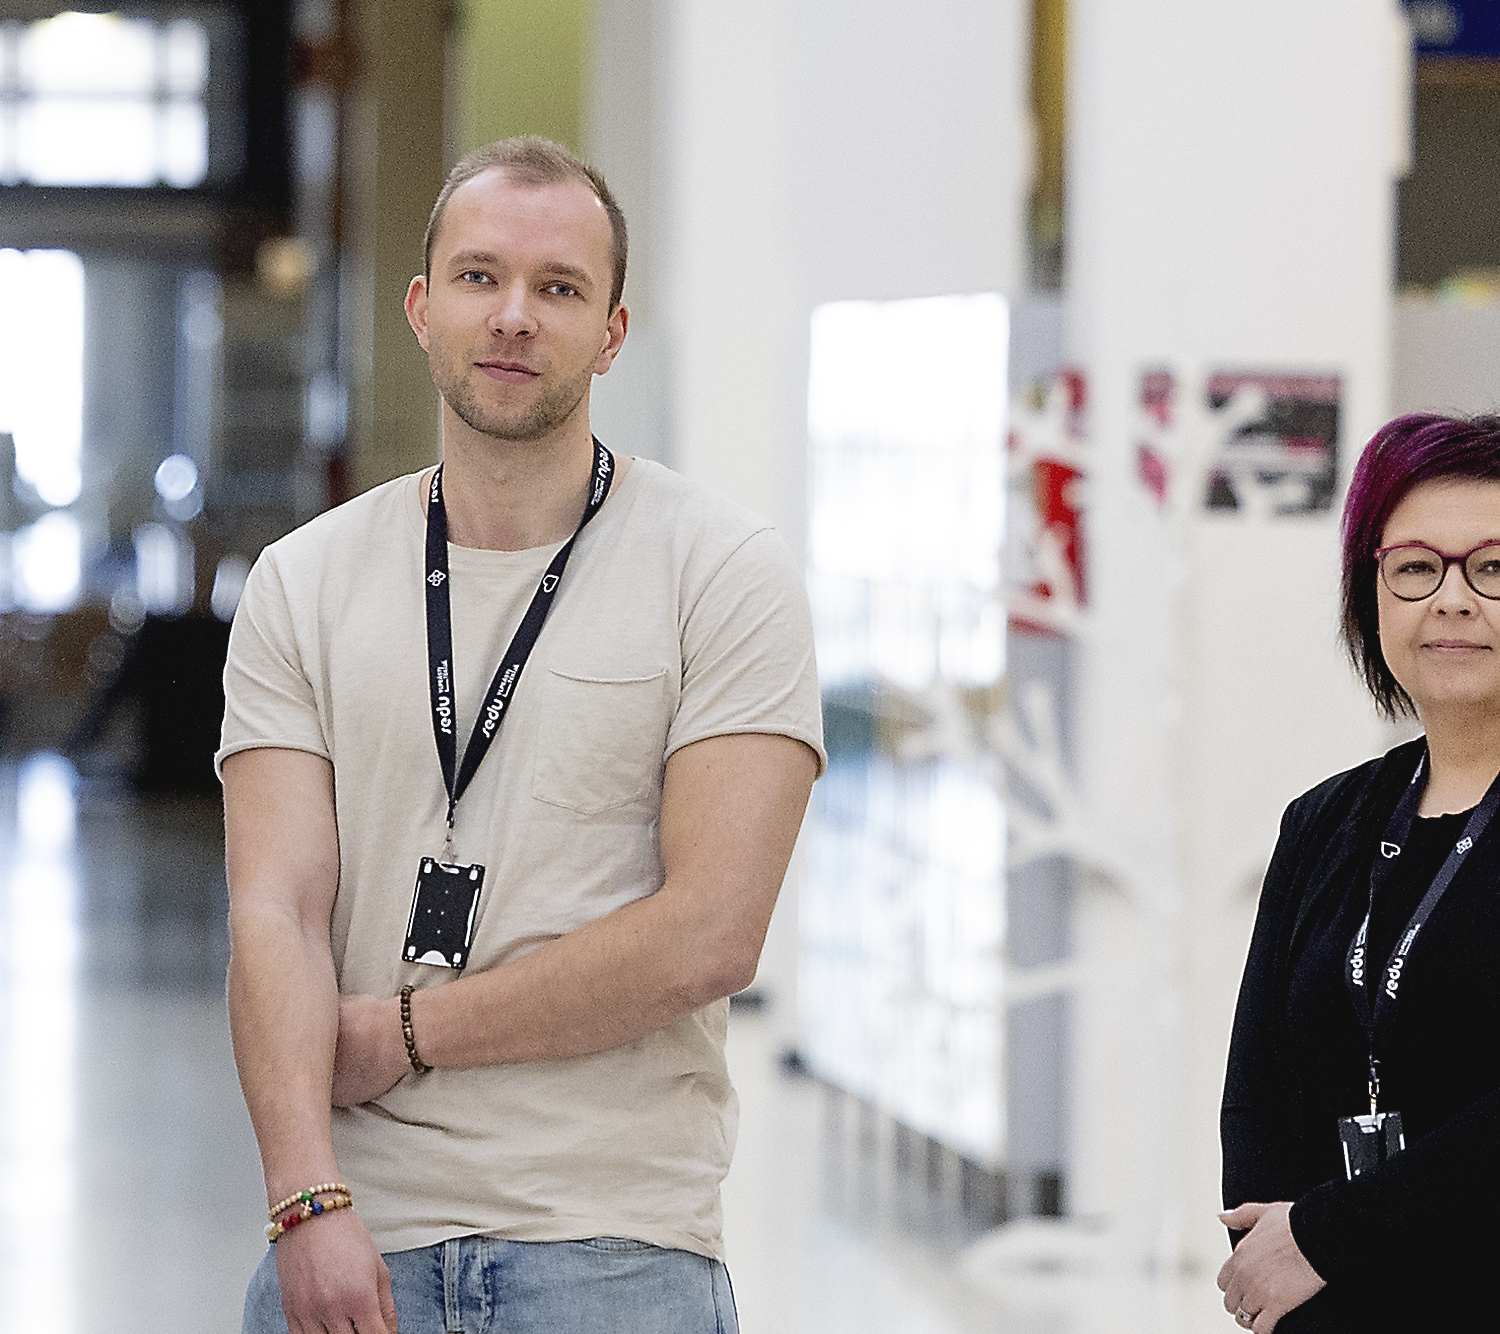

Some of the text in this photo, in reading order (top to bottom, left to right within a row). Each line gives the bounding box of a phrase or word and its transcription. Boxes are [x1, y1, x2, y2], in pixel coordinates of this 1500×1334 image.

[435, 696, 452, 735] sedu
[482, 698, 504, 739] sedu
[1349, 948, 1364, 986] sedu
[1385, 958, 1403, 1000] sedu
